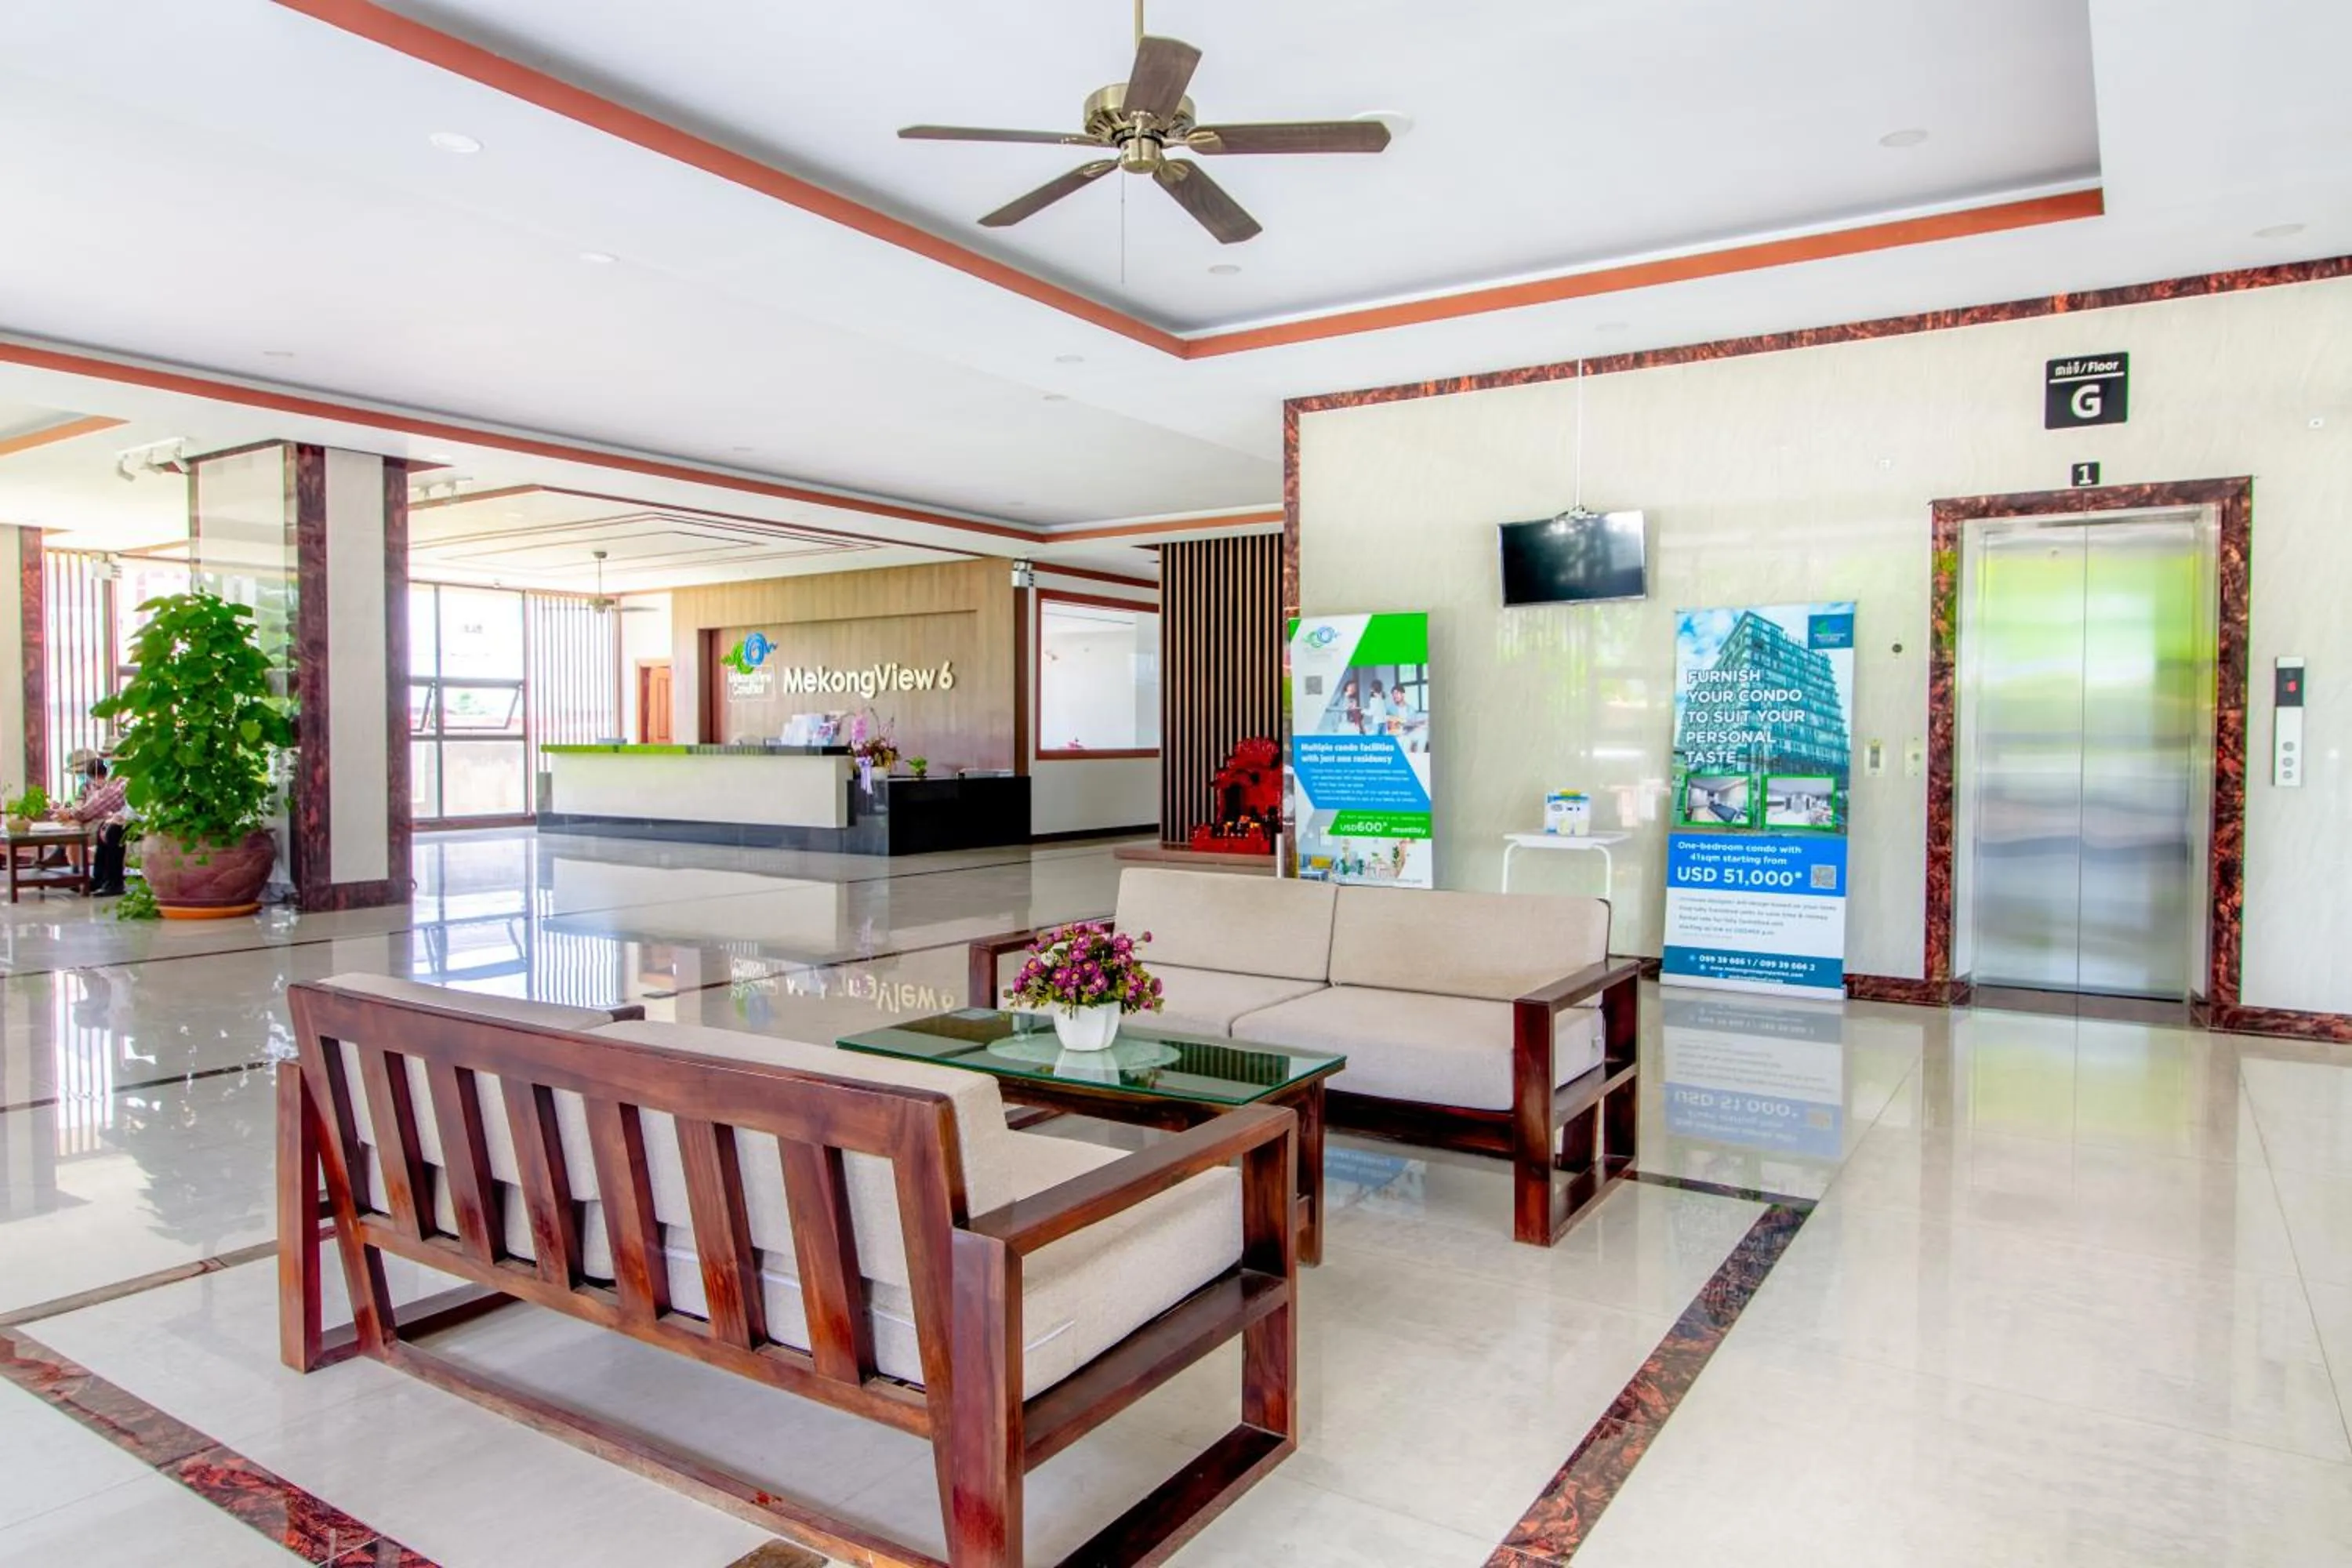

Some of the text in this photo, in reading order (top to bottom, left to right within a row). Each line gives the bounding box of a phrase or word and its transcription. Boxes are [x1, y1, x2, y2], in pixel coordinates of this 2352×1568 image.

[2071, 383, 2102, 419] G
[2078, 465, 2092, 485] 1
[939, 660, 954, 690] 6
[1686, 670, 1761, 684] FURNISH
[1687, 689, 1802, 703] YOUR CONDO
[1687, 710, 1806, 724] TO SUIT YOUR
[1686, 730, 1777, 744] PERSONAL
[1359, 742, 1395, 752] facilities
[1686, 750, 1737, 764] TASTE
[1677, 840, 1802, 855] One-bedroom condo with
[1690, 852, 1788, 866] 41sqm starting from
[1677, 866, 1718, 883] USD
